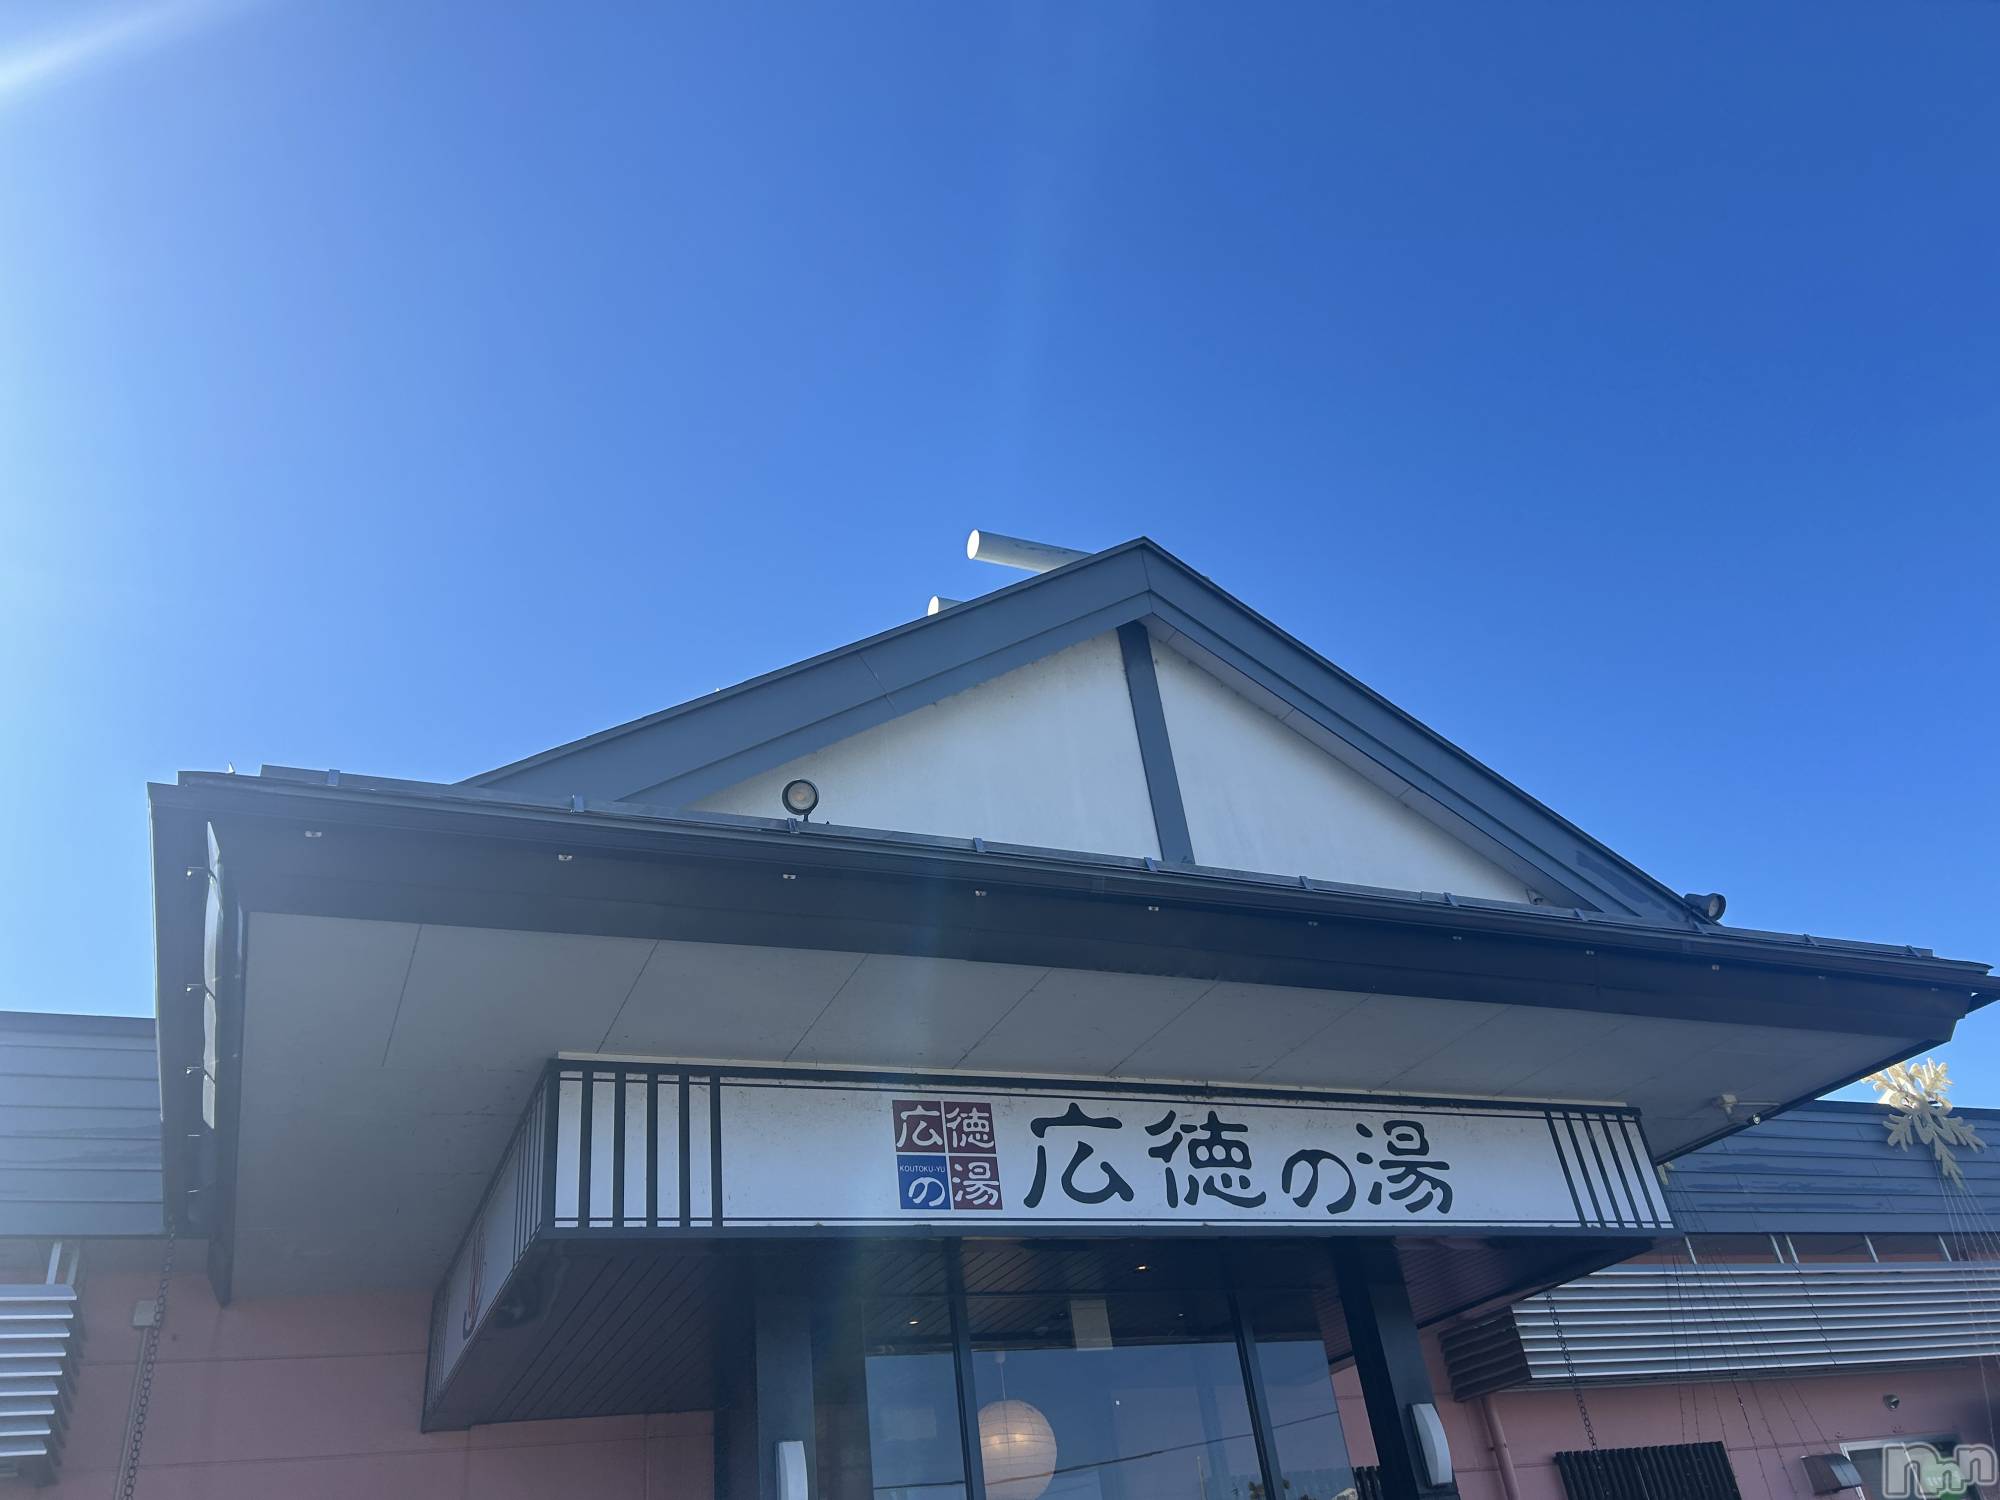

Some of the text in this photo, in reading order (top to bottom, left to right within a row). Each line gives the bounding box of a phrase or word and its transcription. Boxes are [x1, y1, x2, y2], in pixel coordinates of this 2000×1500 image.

[899, 1164, 946, 1174] KOUTOKU-YU
[1023, 1102, 1454, 1215] 広徳の湯
